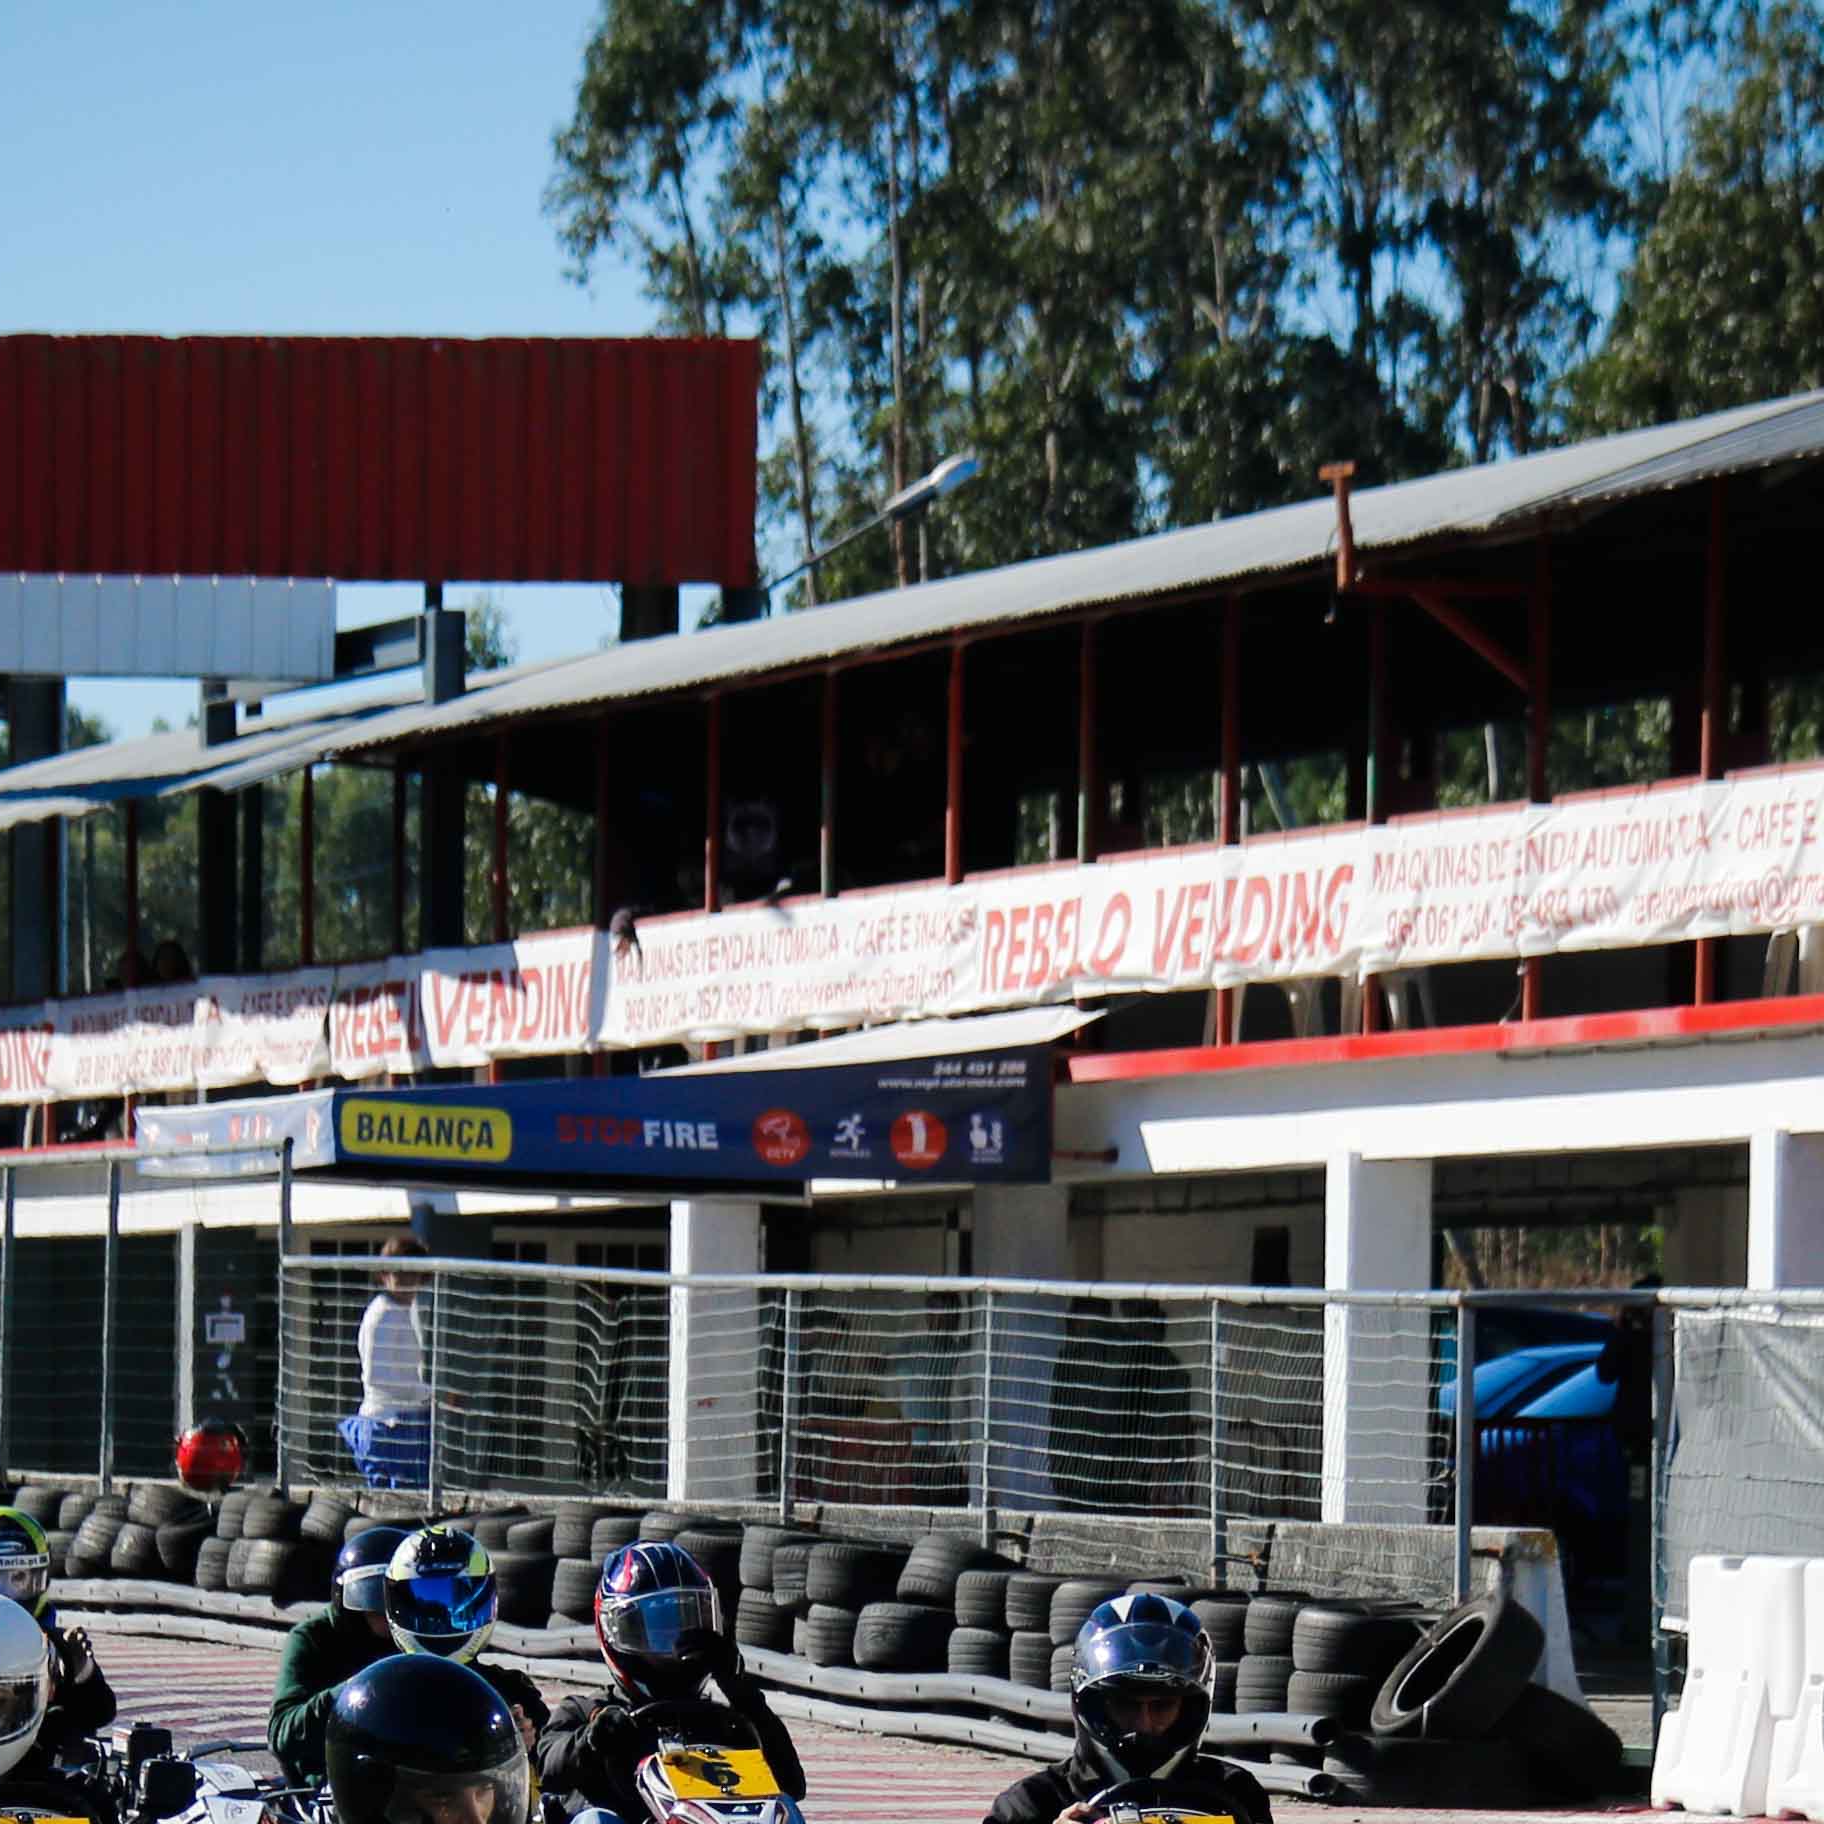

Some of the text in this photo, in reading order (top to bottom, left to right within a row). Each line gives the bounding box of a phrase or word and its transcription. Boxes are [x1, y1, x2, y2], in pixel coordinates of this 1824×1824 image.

[1152, 864, 1355, 974] VENDING
[356, 1112, 495, 1155] BALANÇA
[557, 1114, 719, 1151] STOPFIRE
